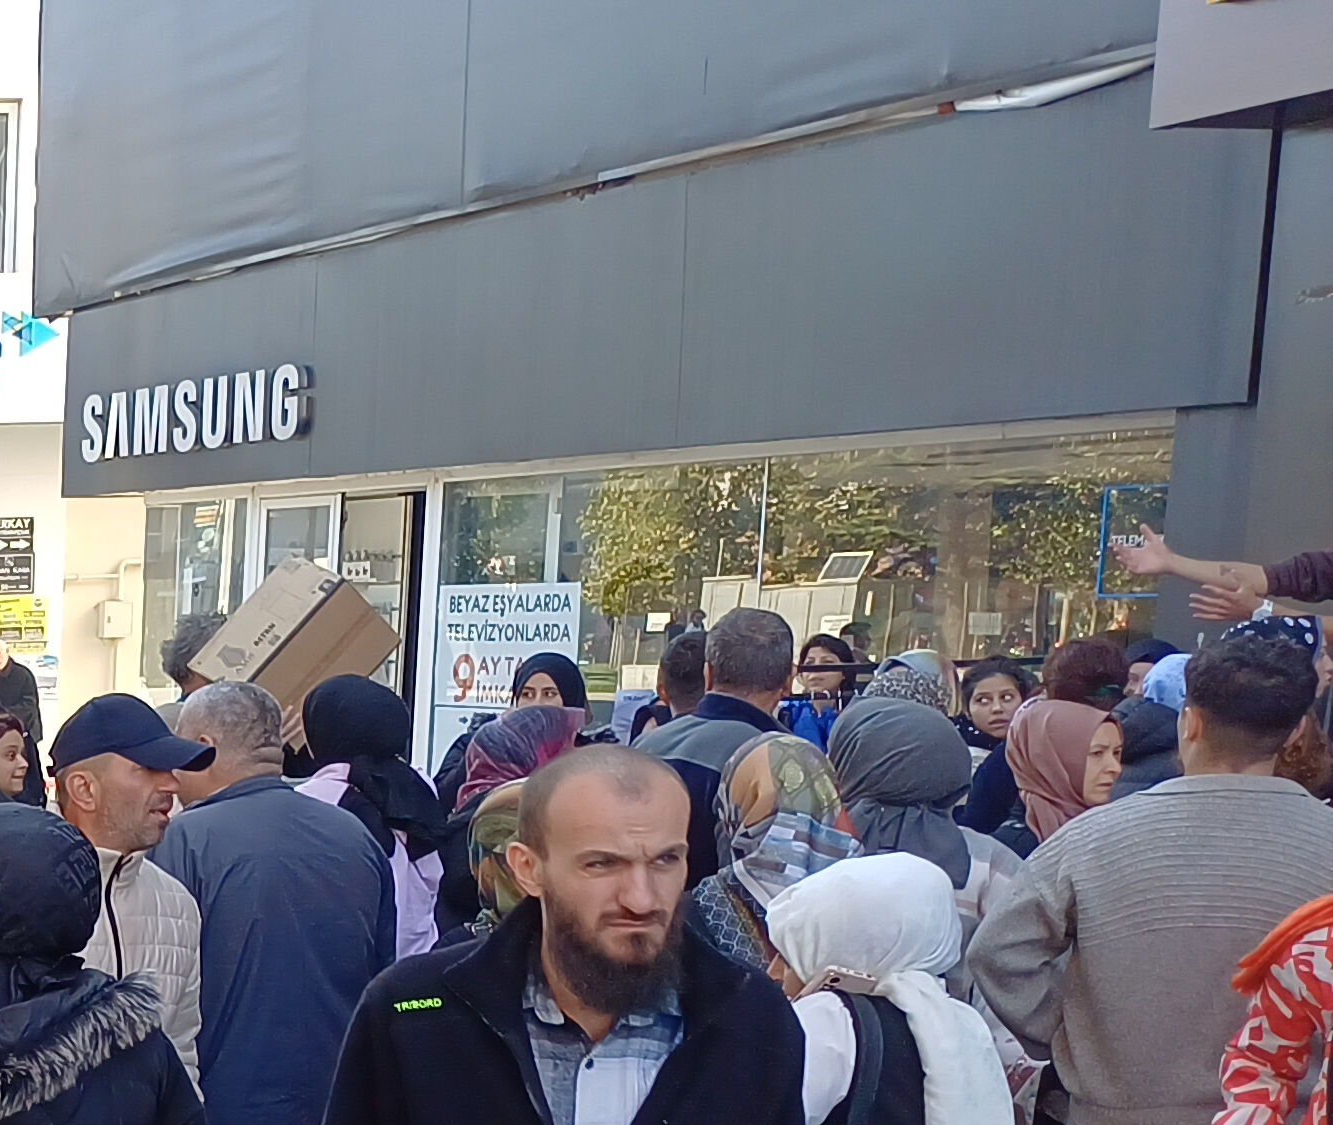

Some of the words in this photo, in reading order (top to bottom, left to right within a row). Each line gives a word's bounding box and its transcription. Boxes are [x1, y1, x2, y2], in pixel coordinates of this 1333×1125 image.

[81, 363, 300, 464] SAMSUNG
[448, 594, 489, 614] BEYAZ
[492, 593, 572, 617] EŞYALARDA
[446, 619, 571, 642] TELEVİZYONLARDA
[452, 653, 475, 703] 9
[477, 656, 502, 676] AY
[393, 997, 443, 1013] TRIBORD
